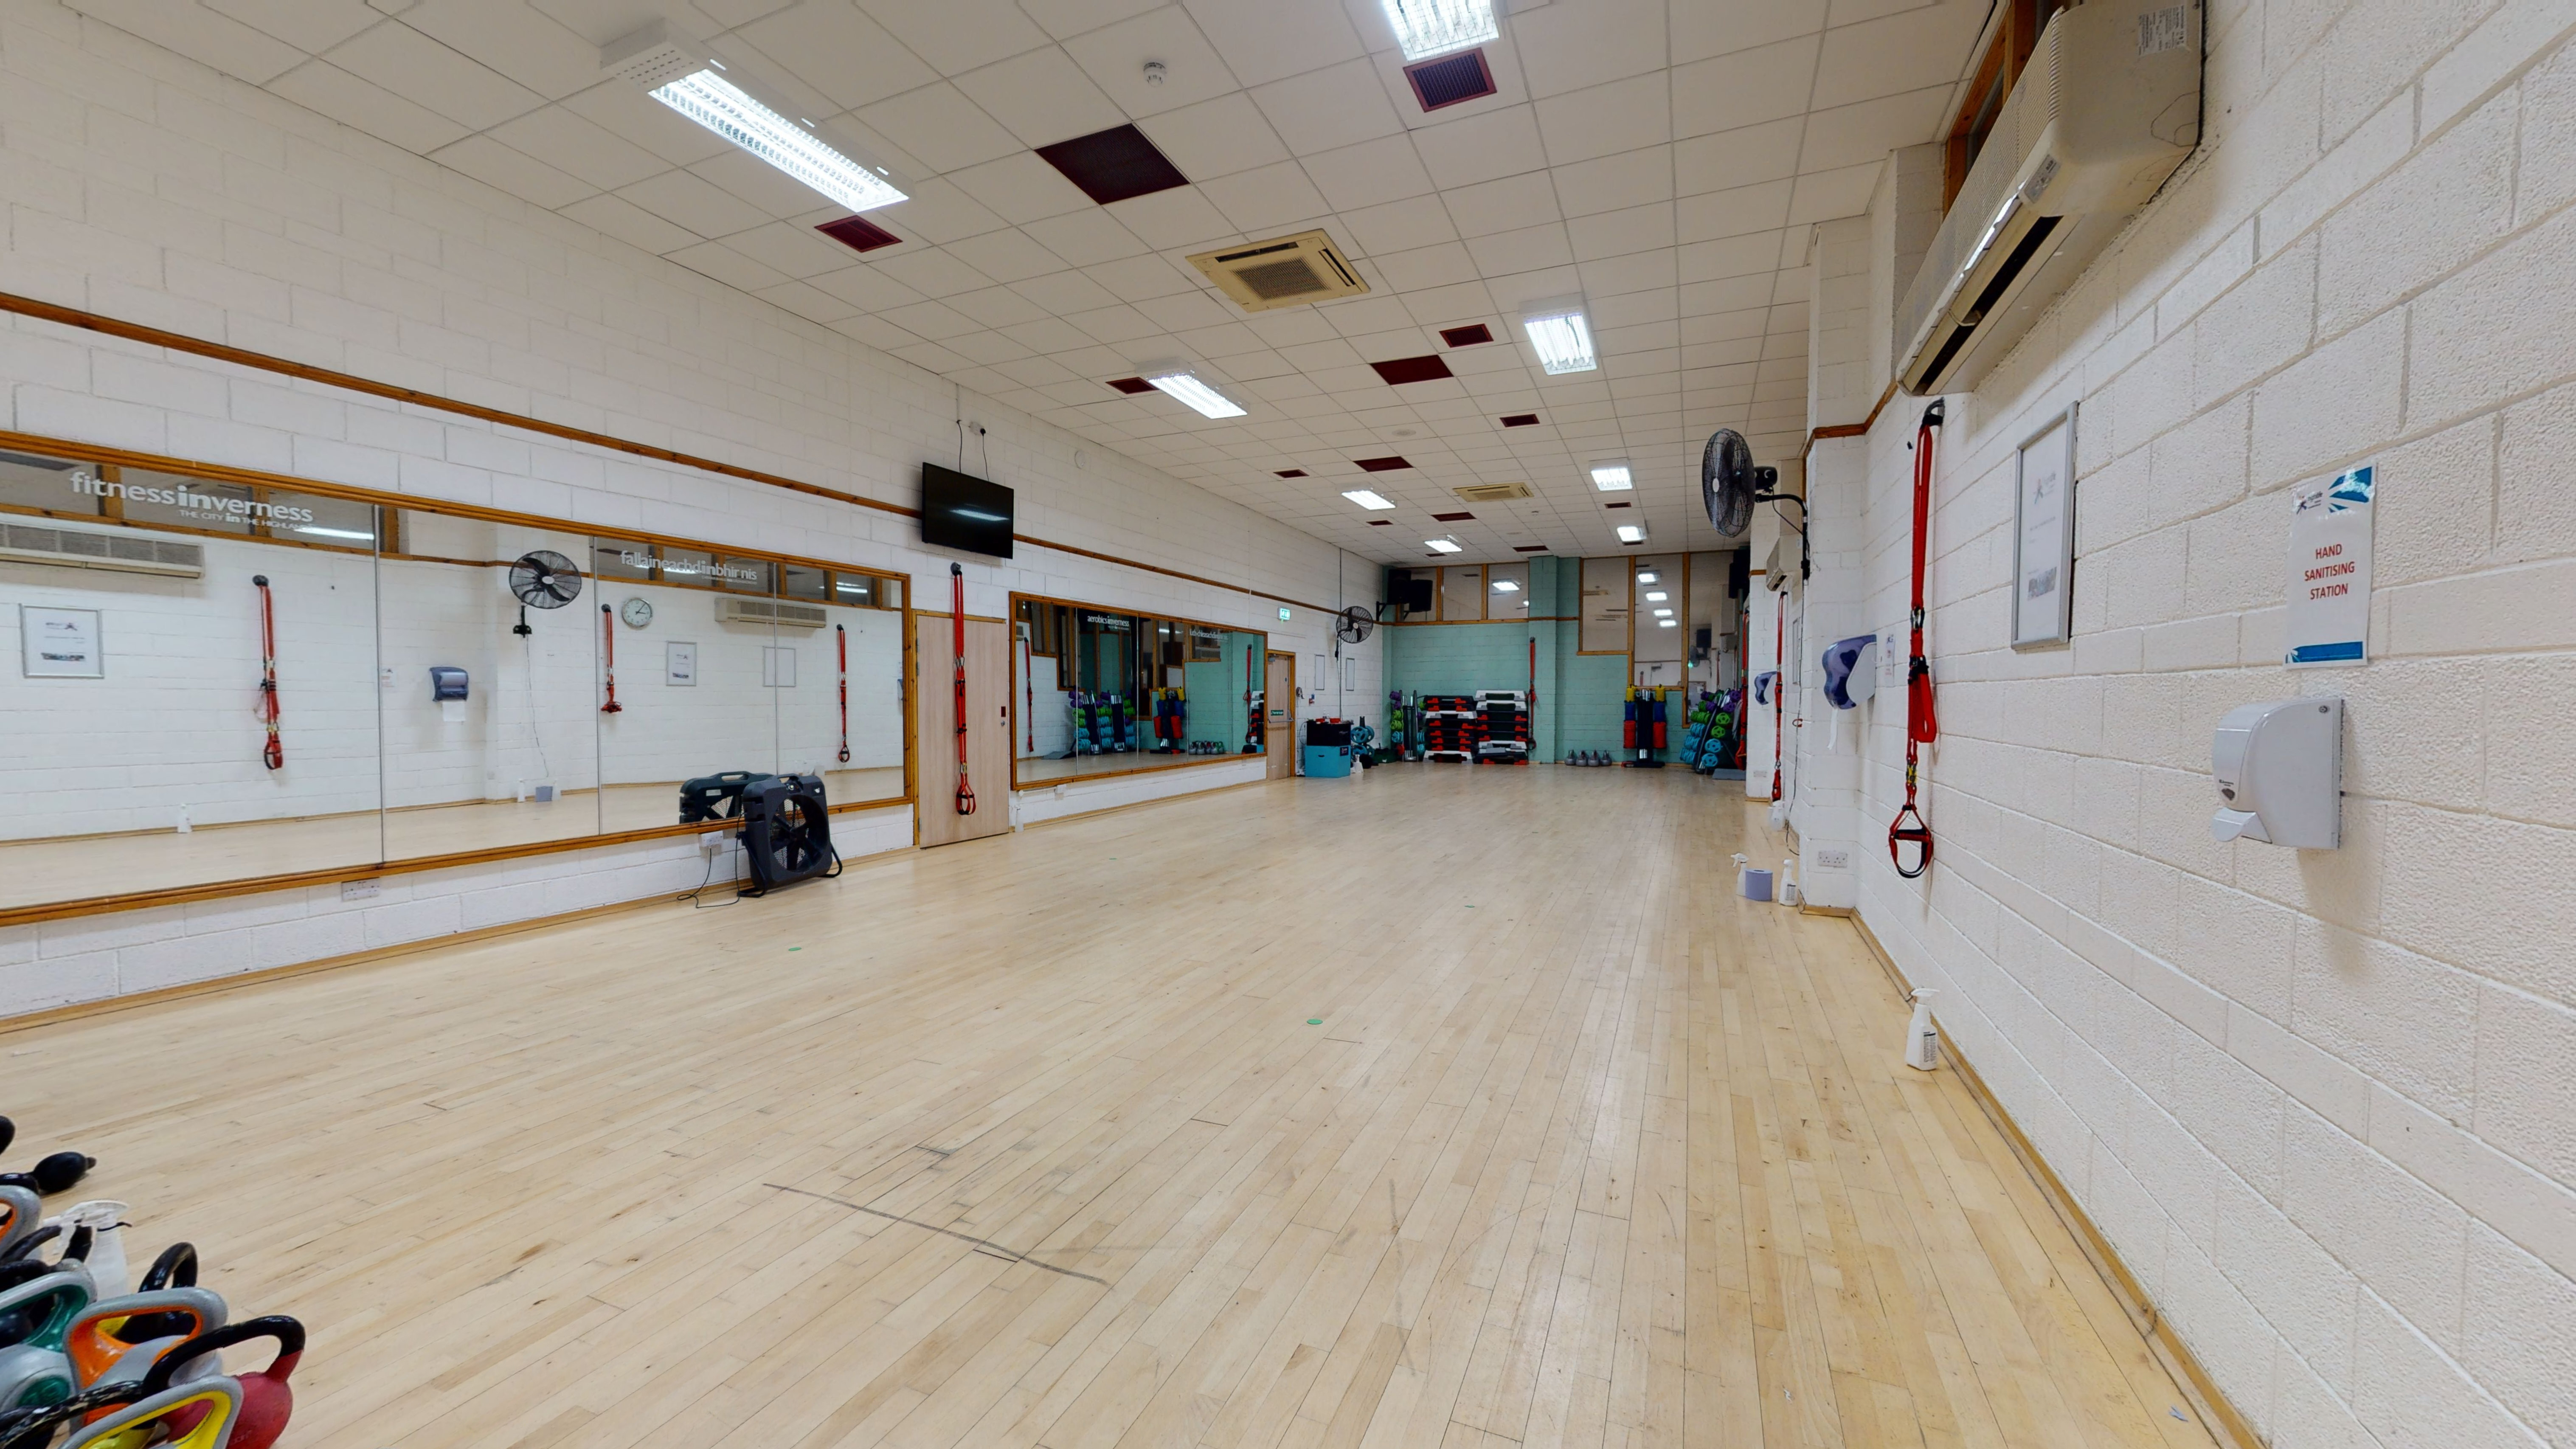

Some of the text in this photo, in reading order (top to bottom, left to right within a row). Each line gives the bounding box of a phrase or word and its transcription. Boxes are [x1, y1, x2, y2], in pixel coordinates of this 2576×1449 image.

[180, 509, 198, 518] THE
[201, 512, 223, 521] CITY
[225, 512, 241, 523] in
[241, 518, 259, 526] THE
[2316, 544, 2342, 560] HAND
[2304, 561, 2354, 581] SANITISING
[2310, 583, 2348, 600] STATION
